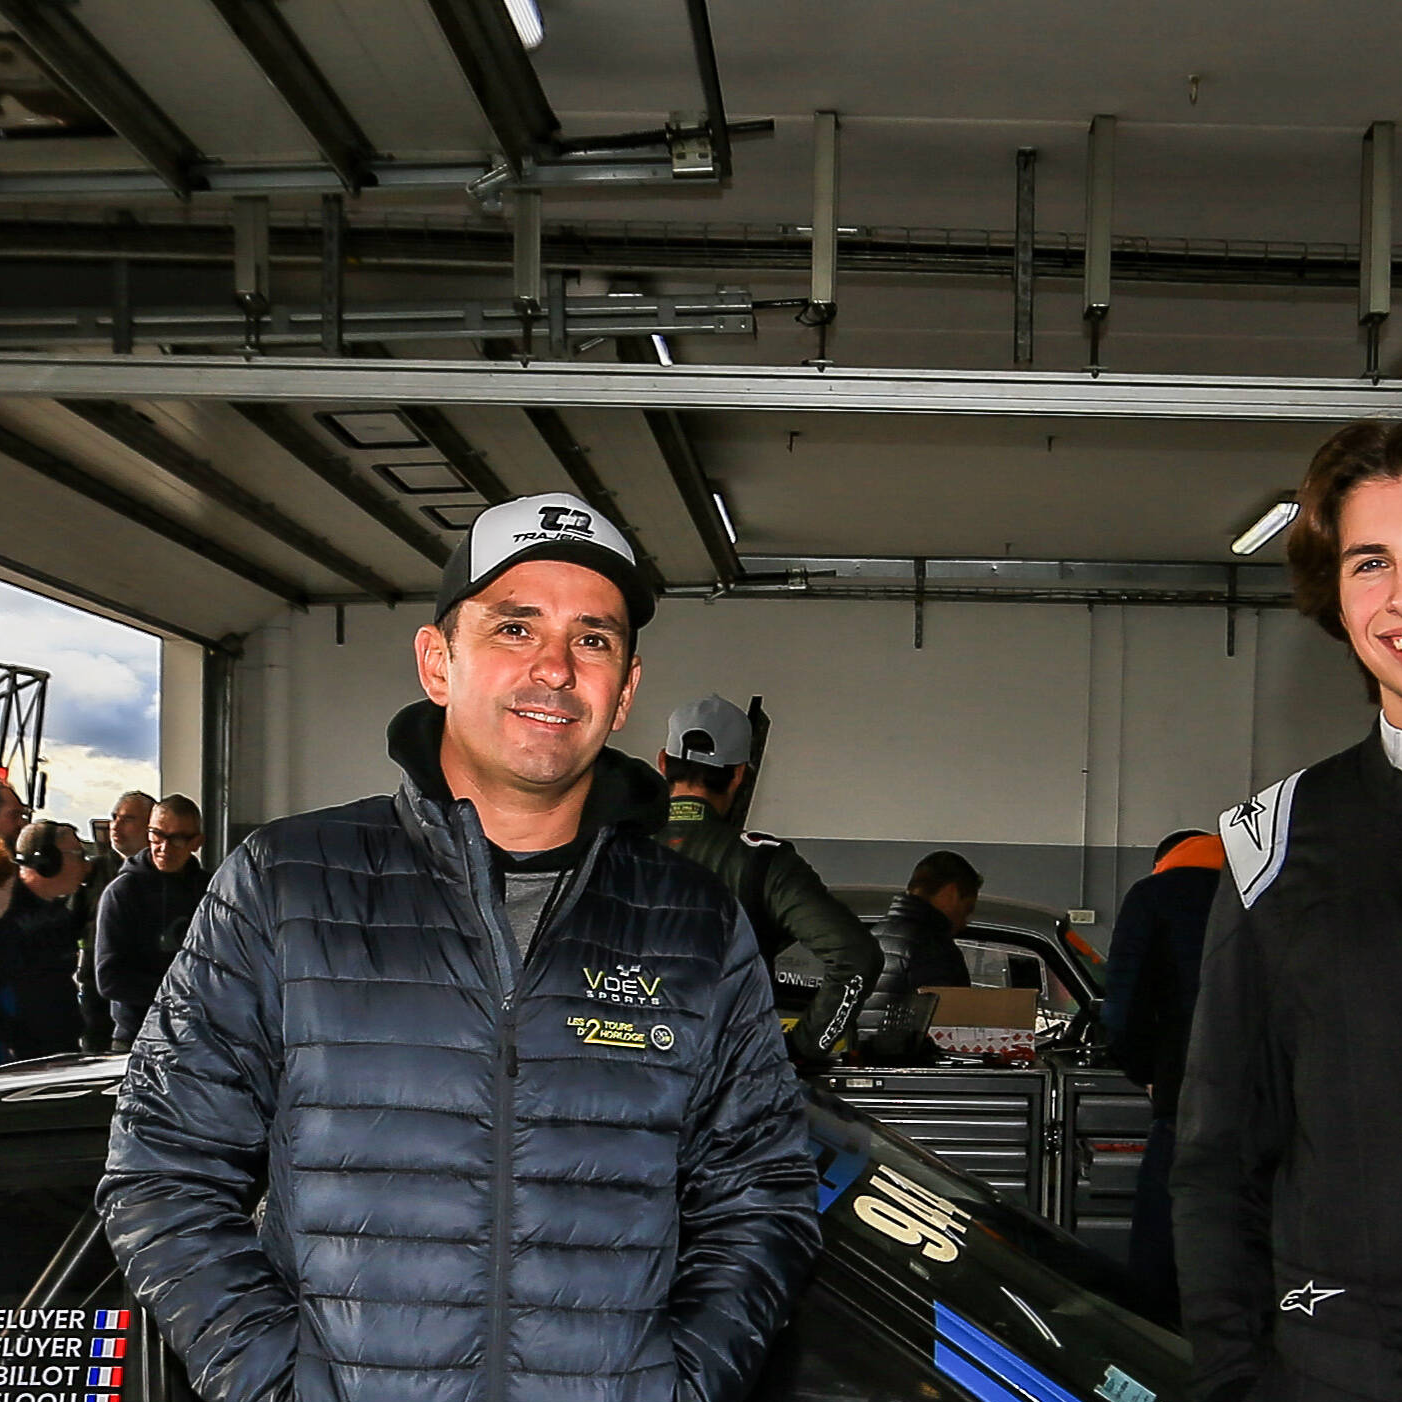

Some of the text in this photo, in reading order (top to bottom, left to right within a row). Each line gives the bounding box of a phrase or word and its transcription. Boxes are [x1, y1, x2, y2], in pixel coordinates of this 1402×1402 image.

[585, 989, 661, 1006] SPORTS
[566, 1016, 586, 1027] LES
[603, 1020, 634, 1032] TOURS
[600, 1029, 646, 1042] HORLOGE
